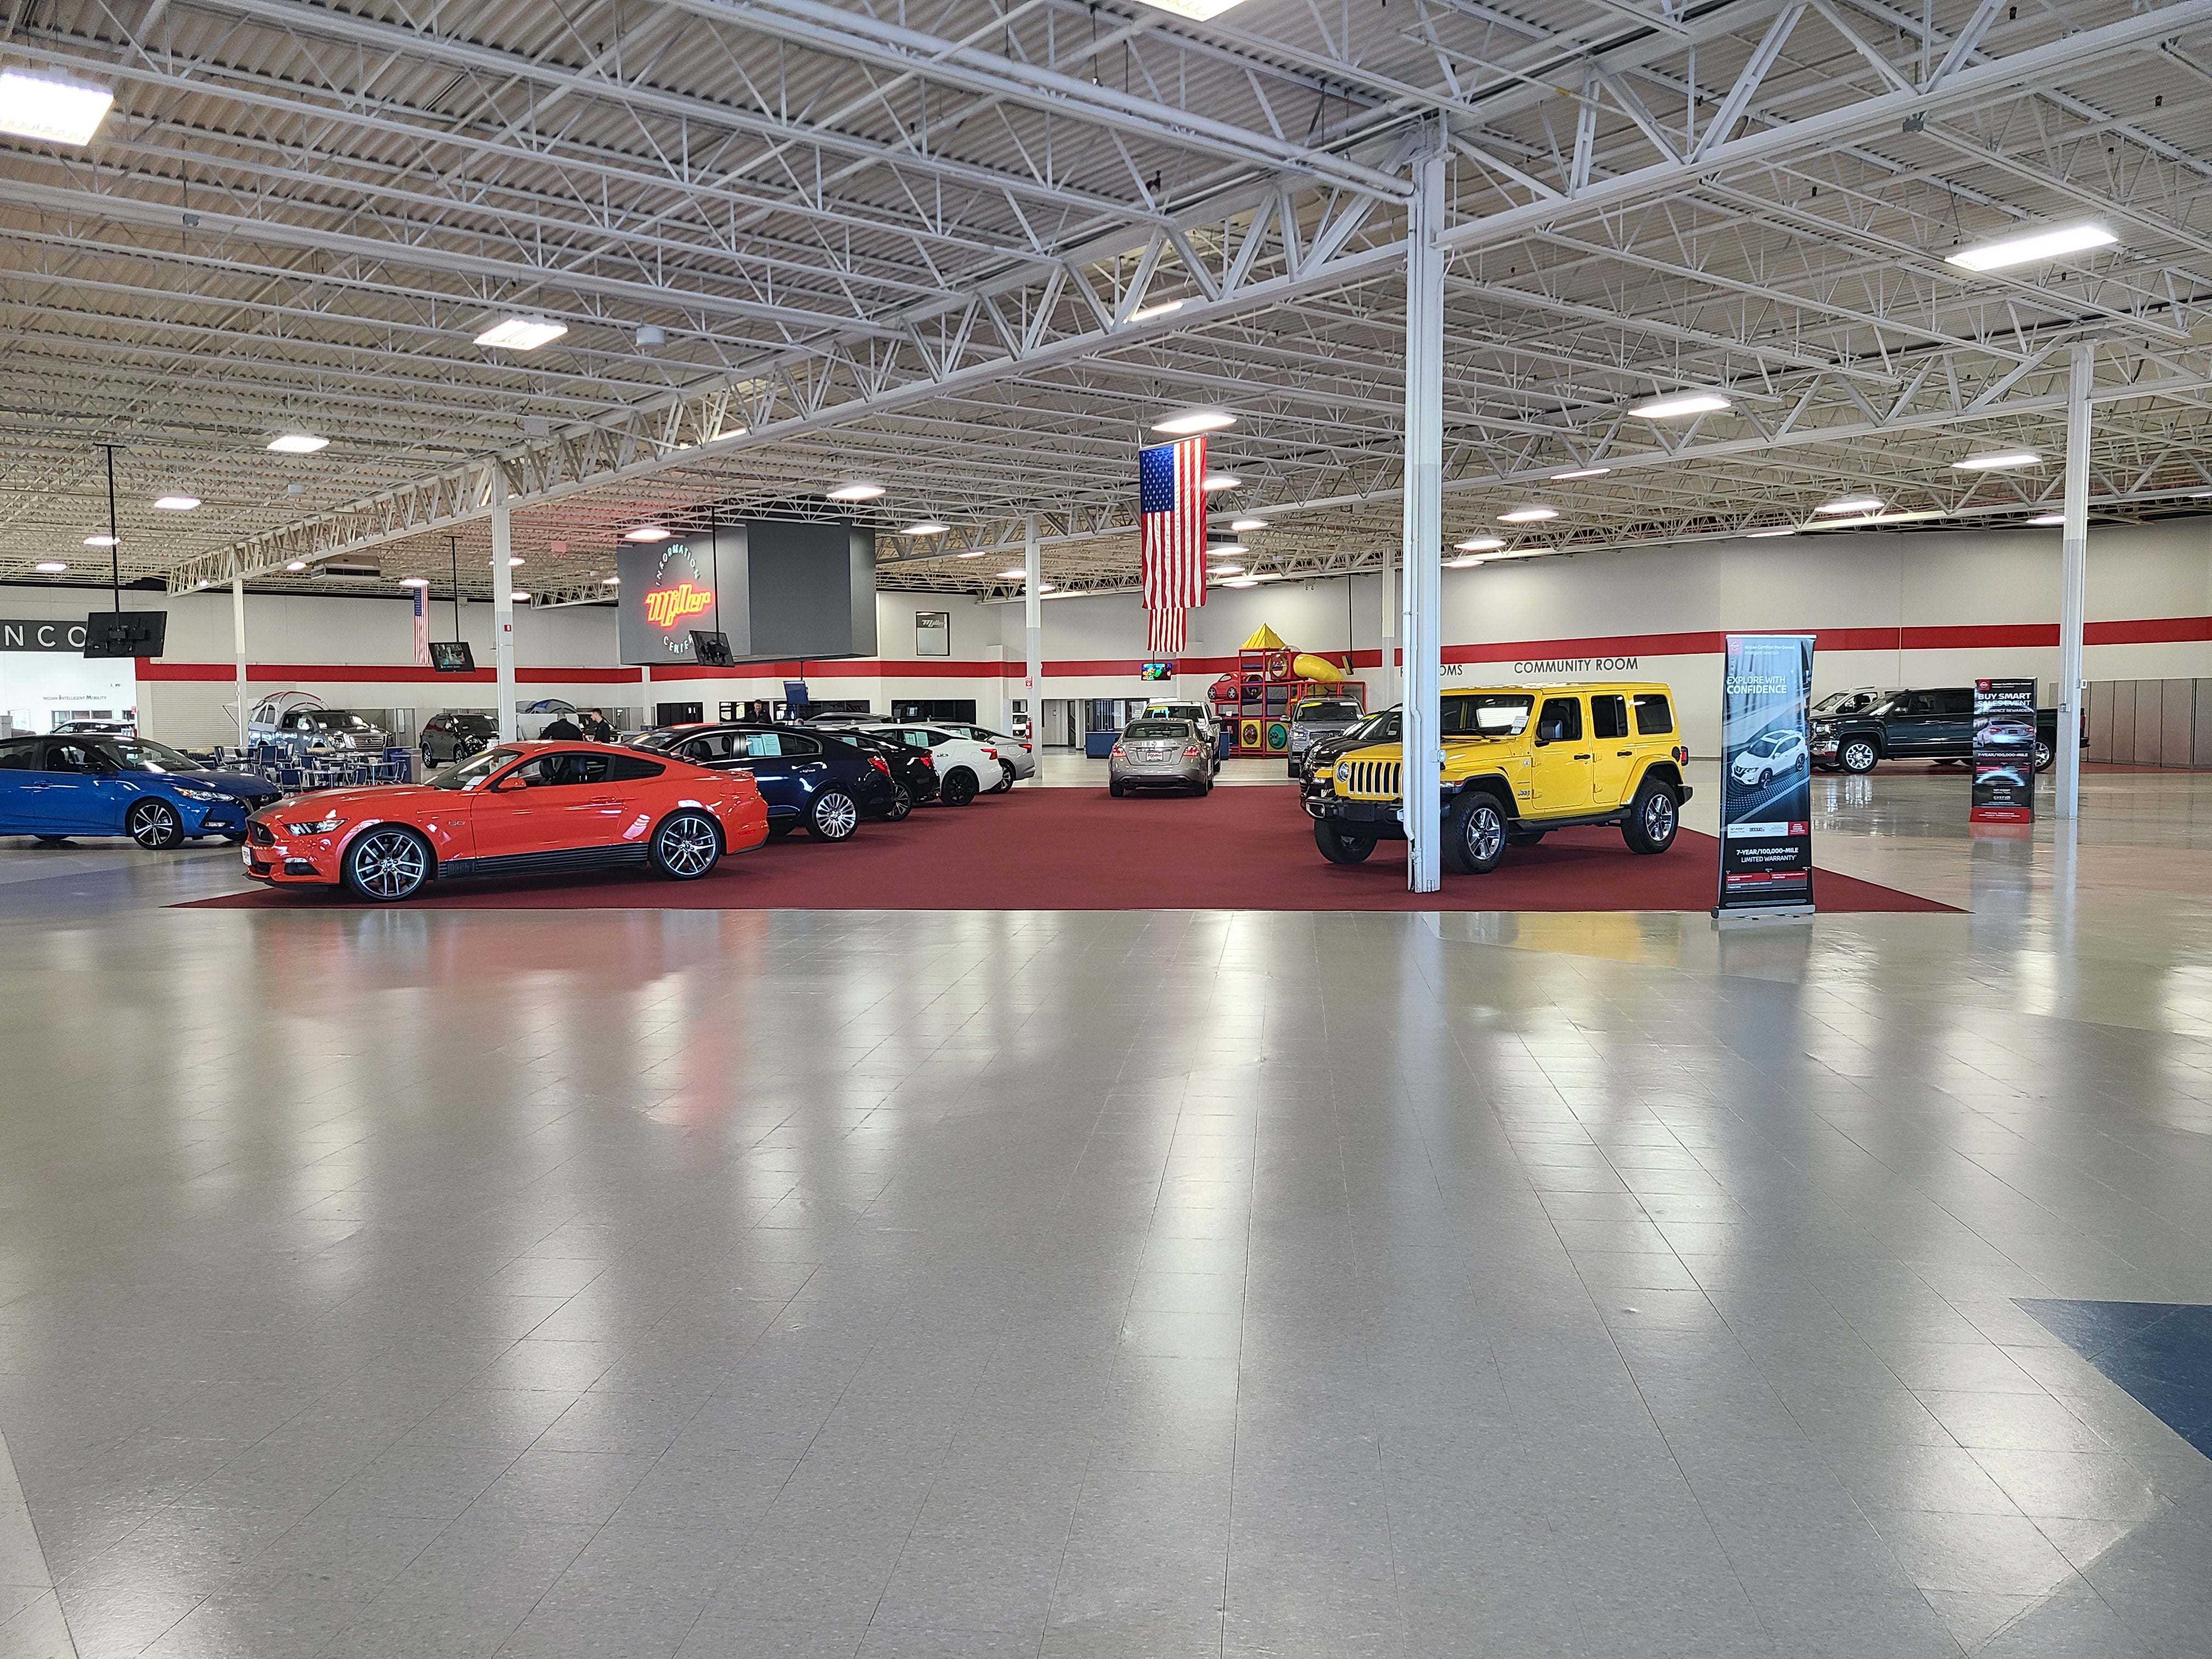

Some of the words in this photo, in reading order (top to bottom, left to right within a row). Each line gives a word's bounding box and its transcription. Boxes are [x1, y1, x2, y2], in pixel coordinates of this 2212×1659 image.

[654, 543, 700, 586] INFORMATION
[644, 583, 713, 628] Miller
[663, 634, 694, 654] CENTER
[1440, 664, 1463, 676] OMS
[1514, 659, 1592, 674] COMMUNITY
[1595, 657, 1639, 671] ROOM
[1726, 676, 1764, 684] EXPLORE
[1765, 676, 1786, 684] WITH
[1726, 685, 1787, 694] CONFIDENCE
[1736, 847, 1799, 856] 7-YEAR/100,000-MILE
